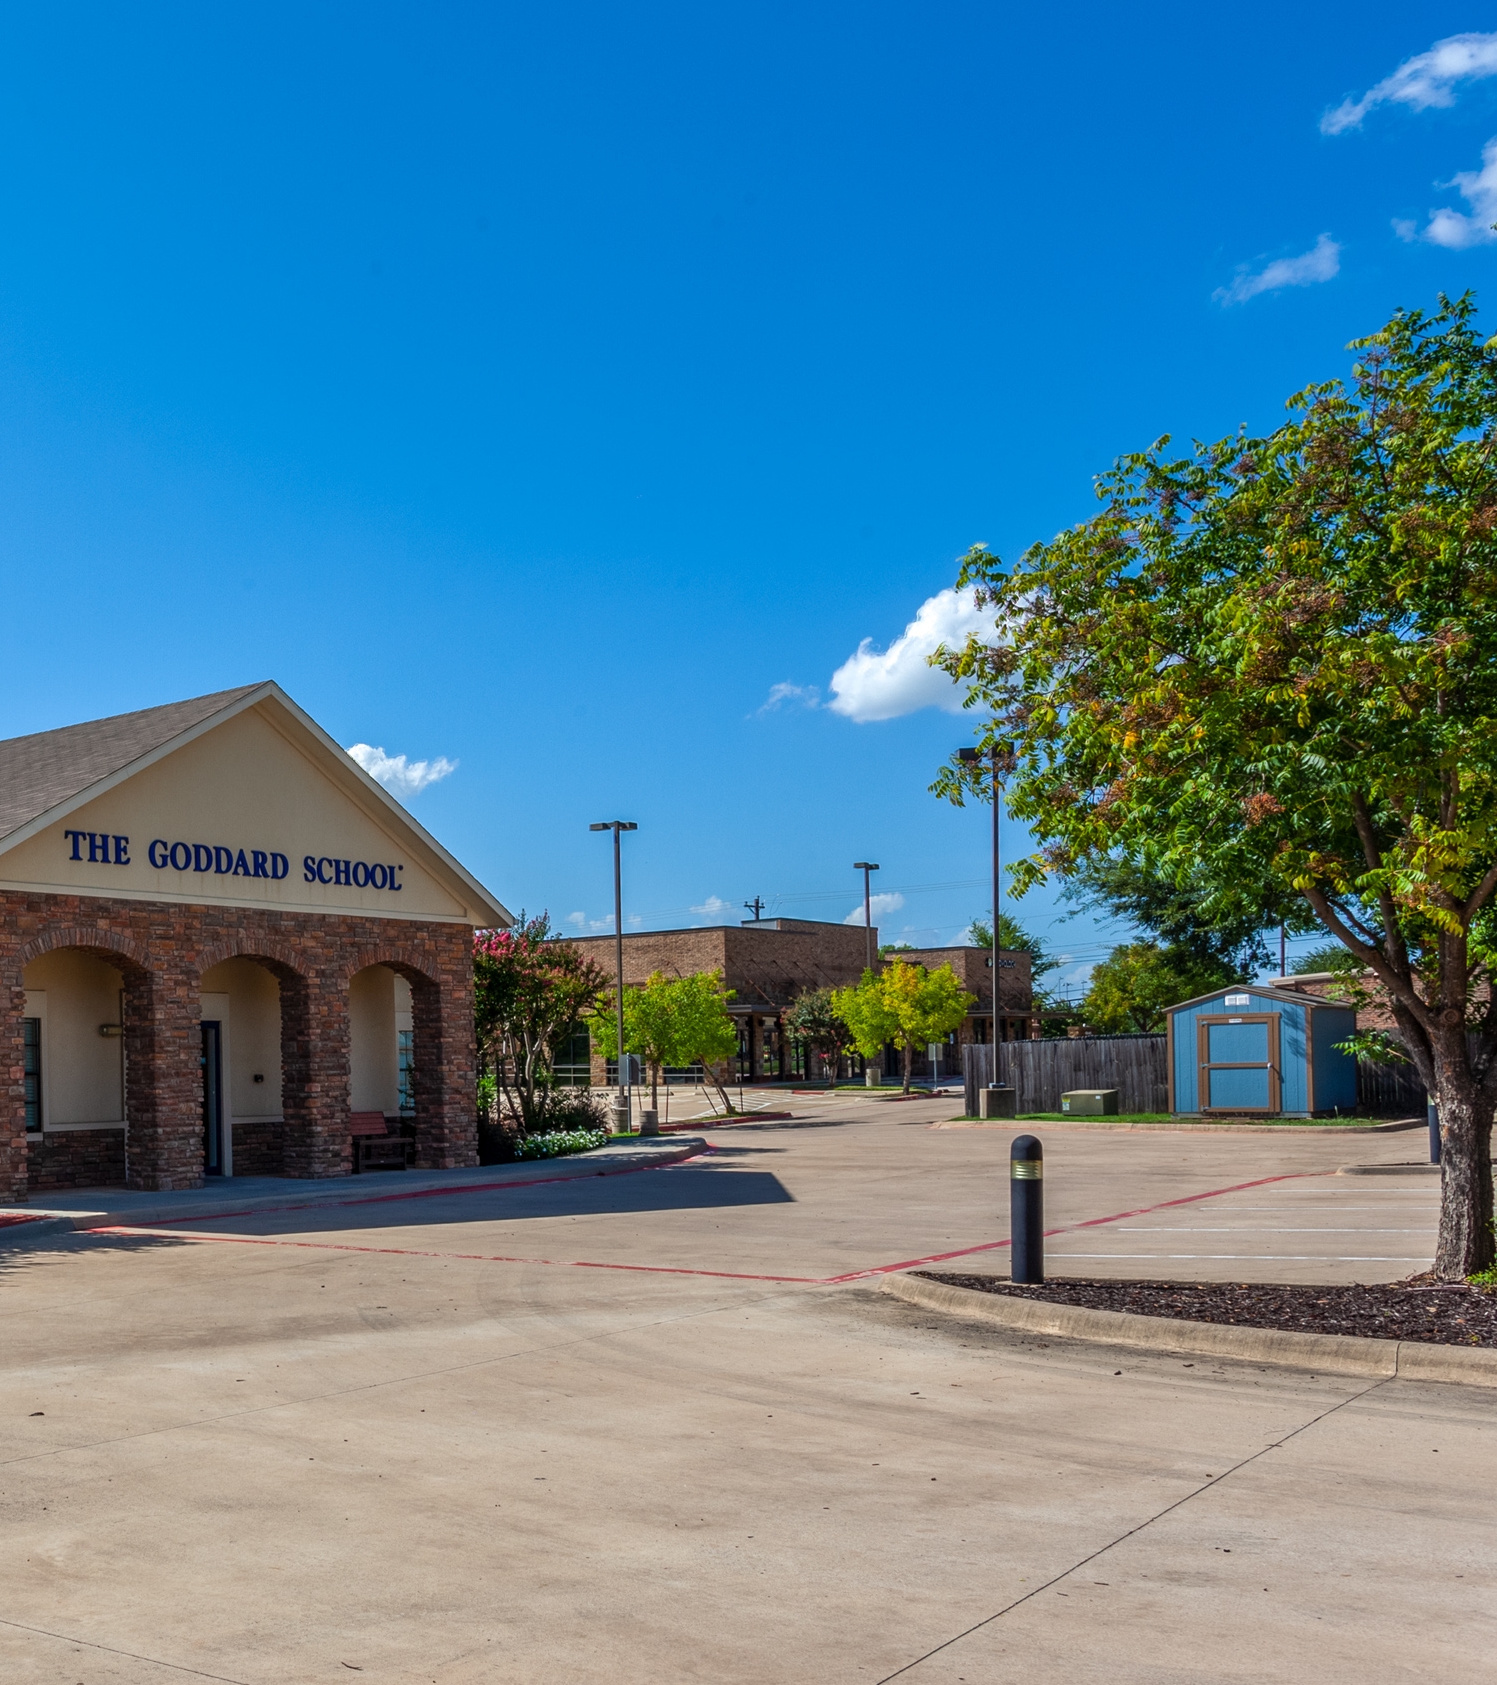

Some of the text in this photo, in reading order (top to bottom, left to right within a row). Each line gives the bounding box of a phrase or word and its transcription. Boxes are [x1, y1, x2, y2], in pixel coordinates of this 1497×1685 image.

[65, 830, 403, 891] THE GODDARD SCHOOL
